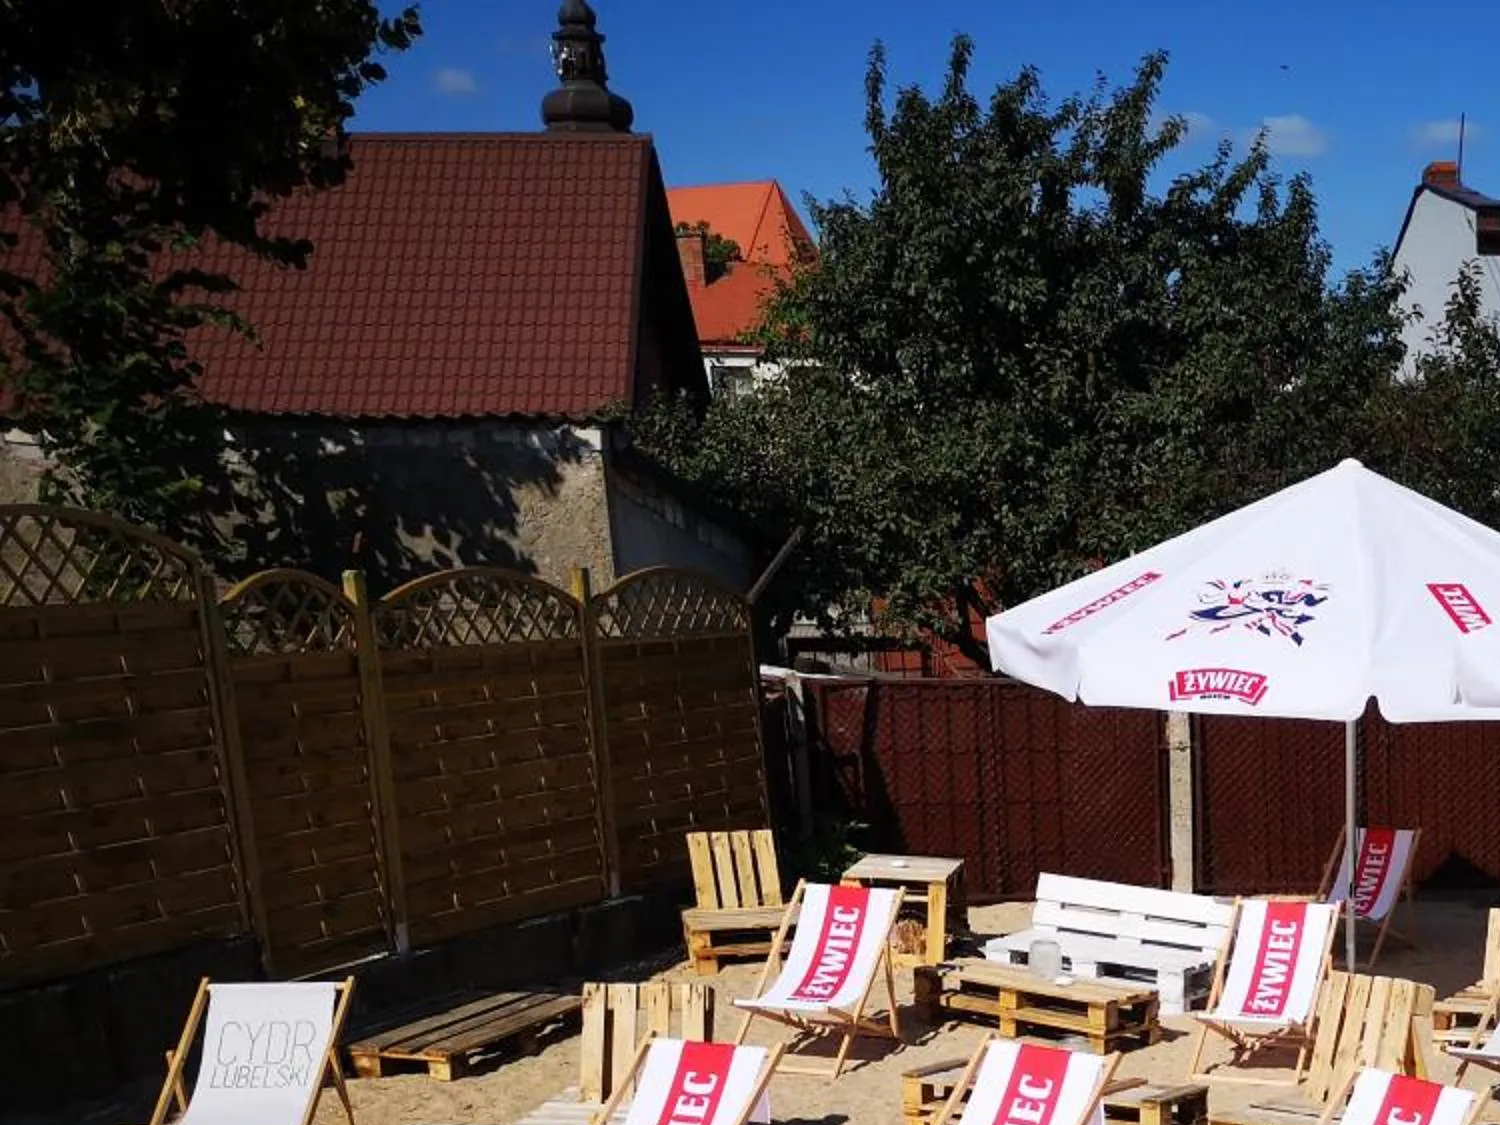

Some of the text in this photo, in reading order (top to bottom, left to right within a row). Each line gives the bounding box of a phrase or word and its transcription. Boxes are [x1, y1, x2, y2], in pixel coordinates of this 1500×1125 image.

[1184, 671, 1254, 693] ŻYWIEC
[803, 906, 860, 998] ŻYWIEC
[1248, 920, 1297, 1011] ŻYWIEC
[215, 1020, 317, 1066] CYDR
[209, 1063, 311, 1089] LUBELSKI
